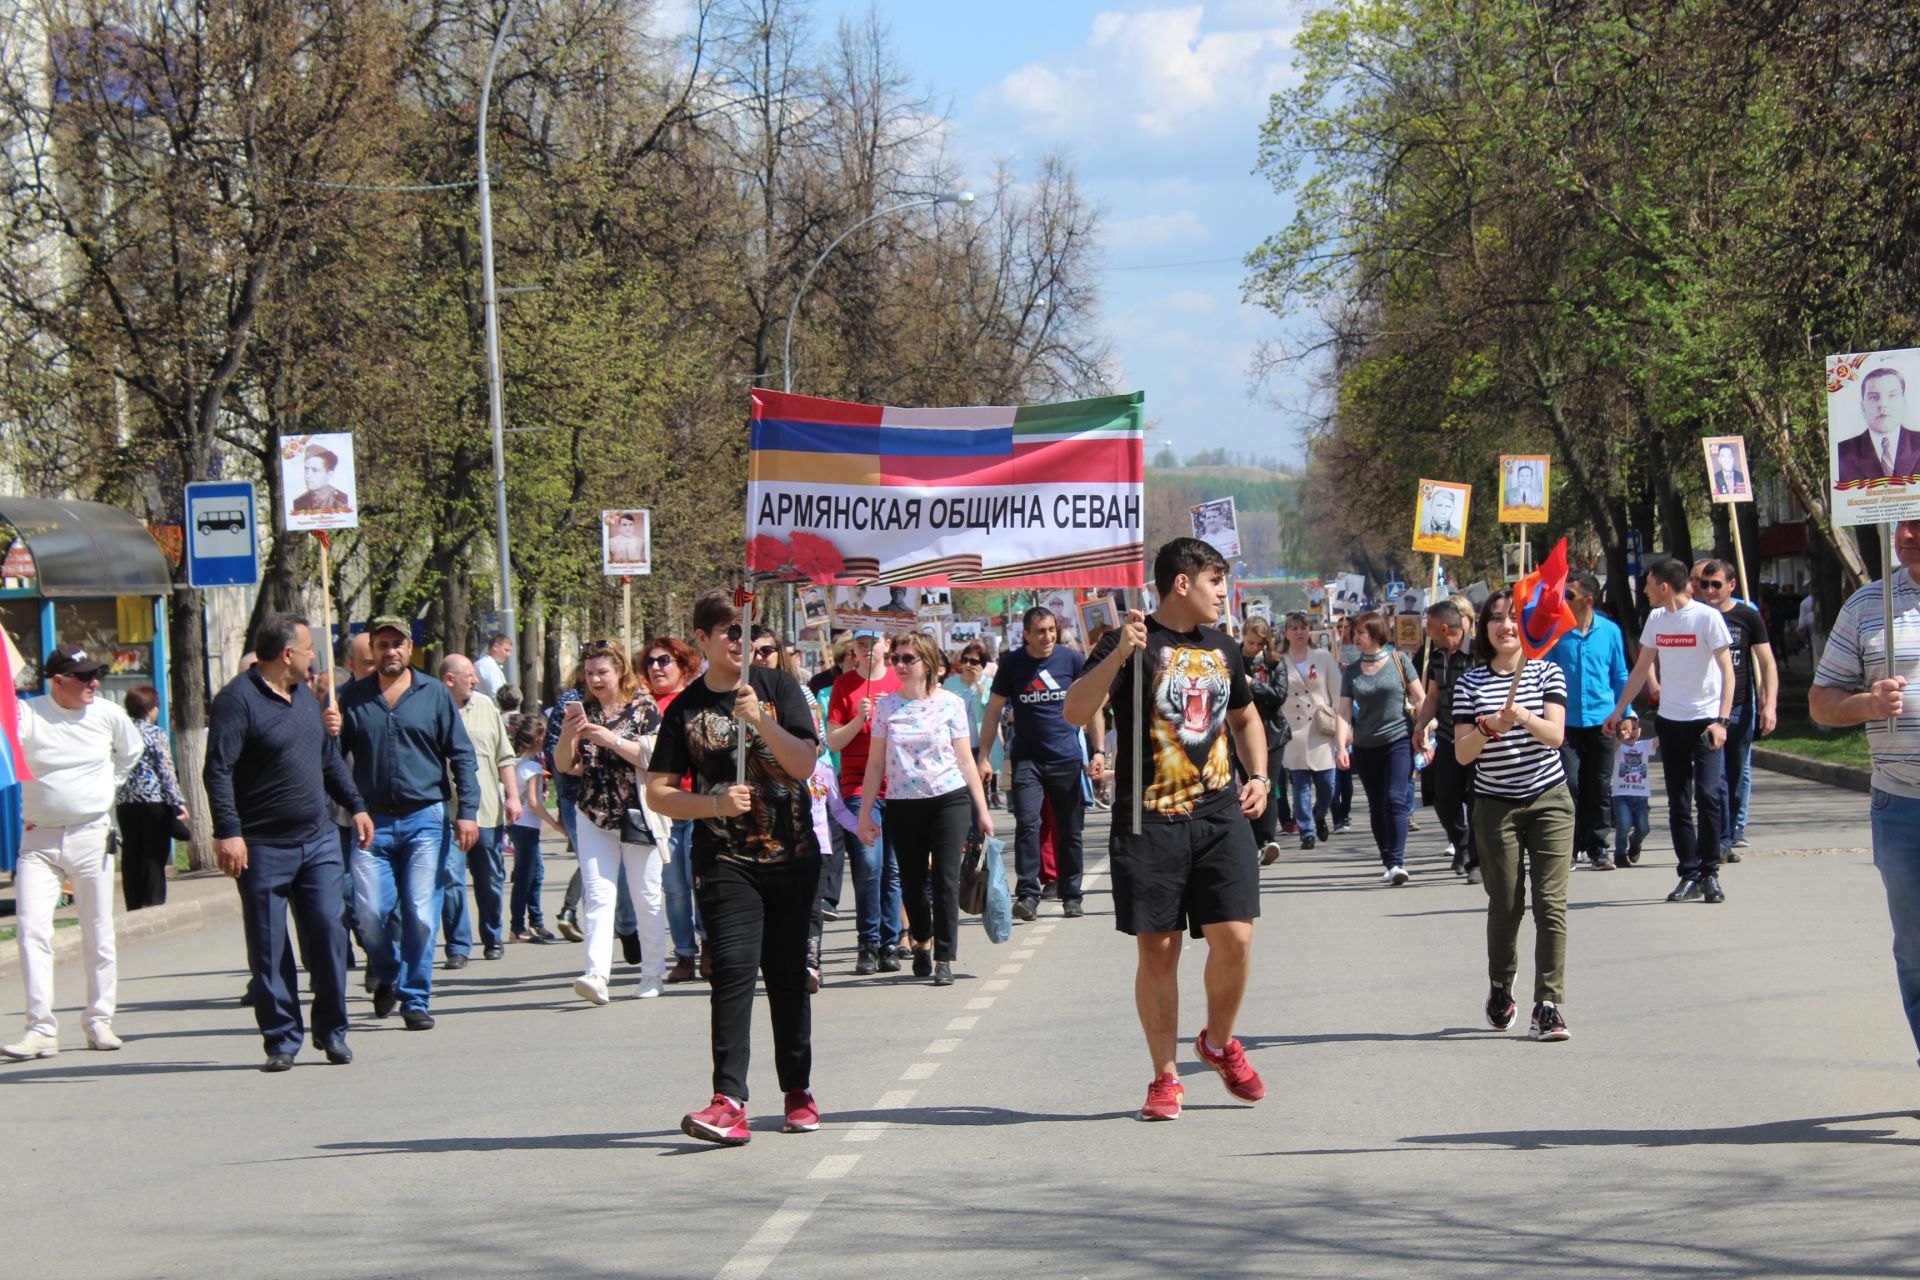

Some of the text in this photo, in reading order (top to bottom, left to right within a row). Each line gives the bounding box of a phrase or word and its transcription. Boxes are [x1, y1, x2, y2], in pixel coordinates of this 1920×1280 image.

[758, 492, 1140, 535] АРМЯНСКАЯ ОБЩИНА СЕВАН
[1656, 635, 1695, 645] Supreme
[1019, 690, 1067, 703] adidas
